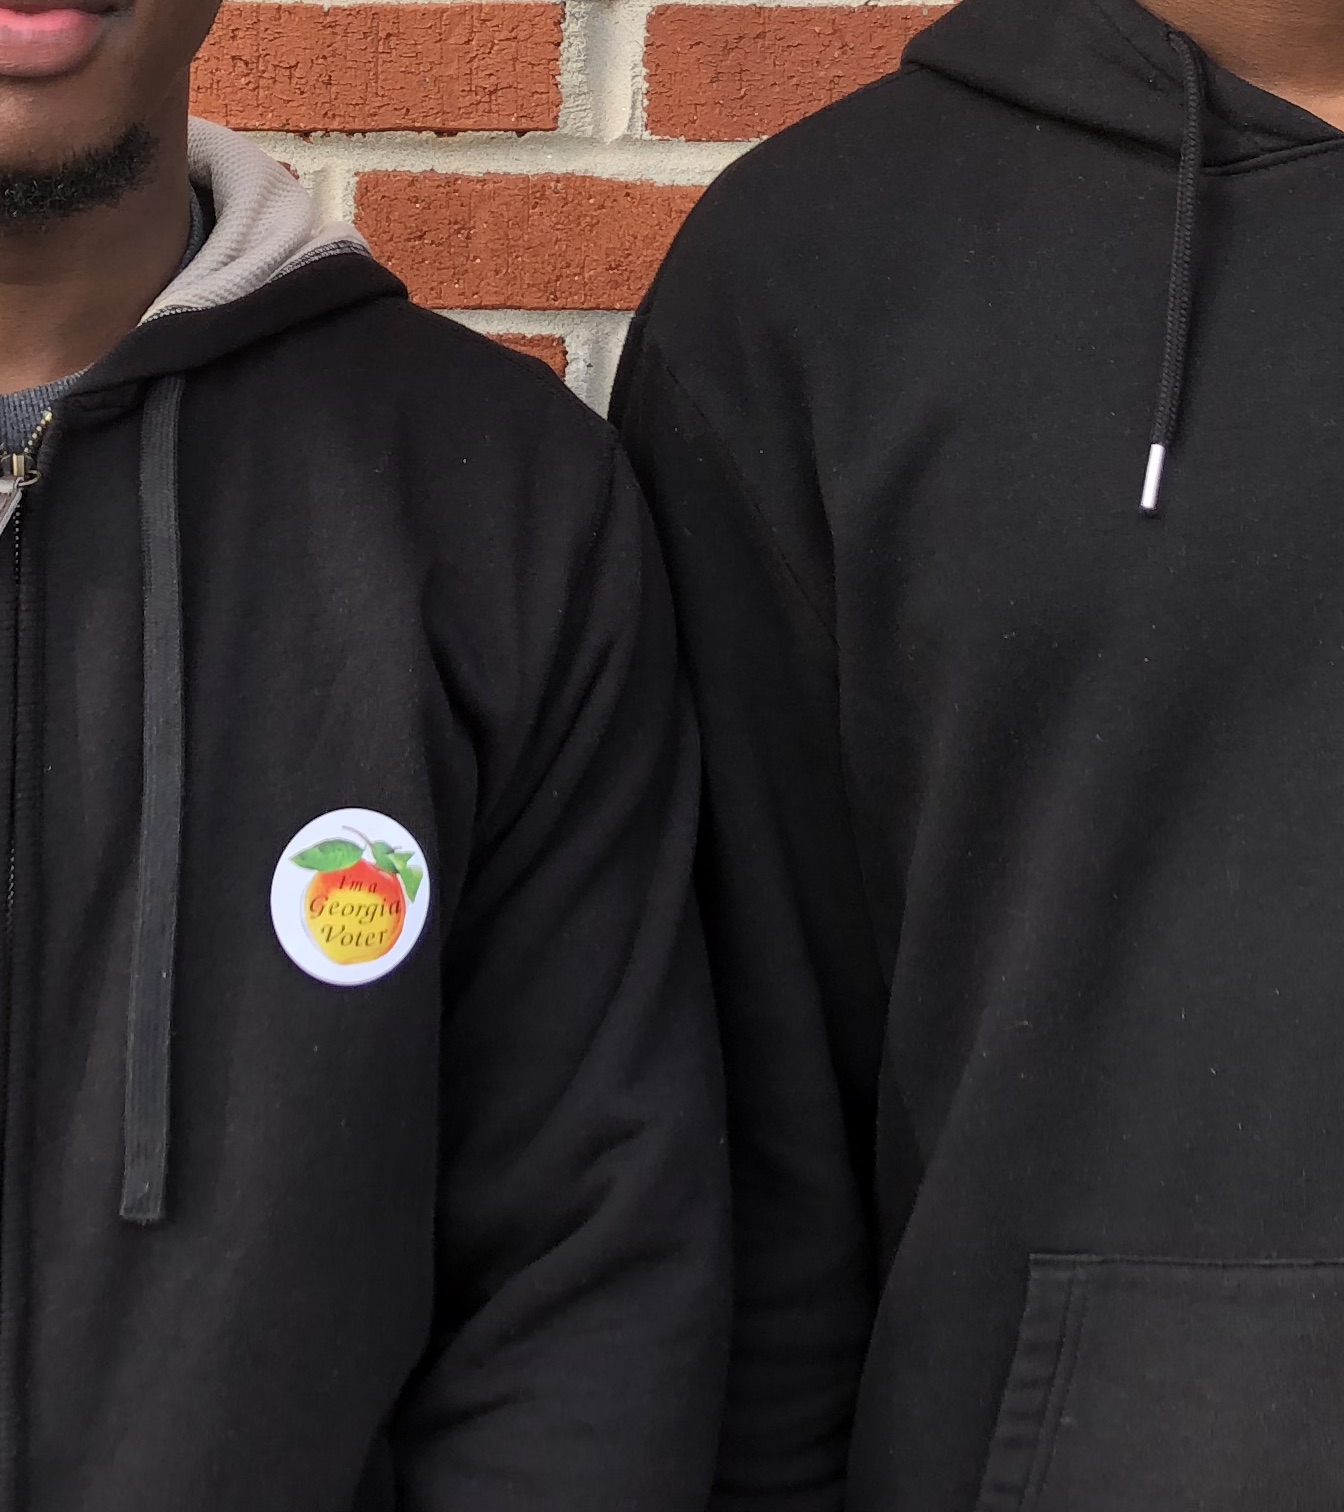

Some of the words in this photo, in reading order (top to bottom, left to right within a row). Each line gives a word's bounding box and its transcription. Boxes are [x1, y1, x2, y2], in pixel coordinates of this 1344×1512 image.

[369, 882, 378, 893] a
[309, 893, 401, 925] Georgia
[321, 924, 388, 947] Voter
